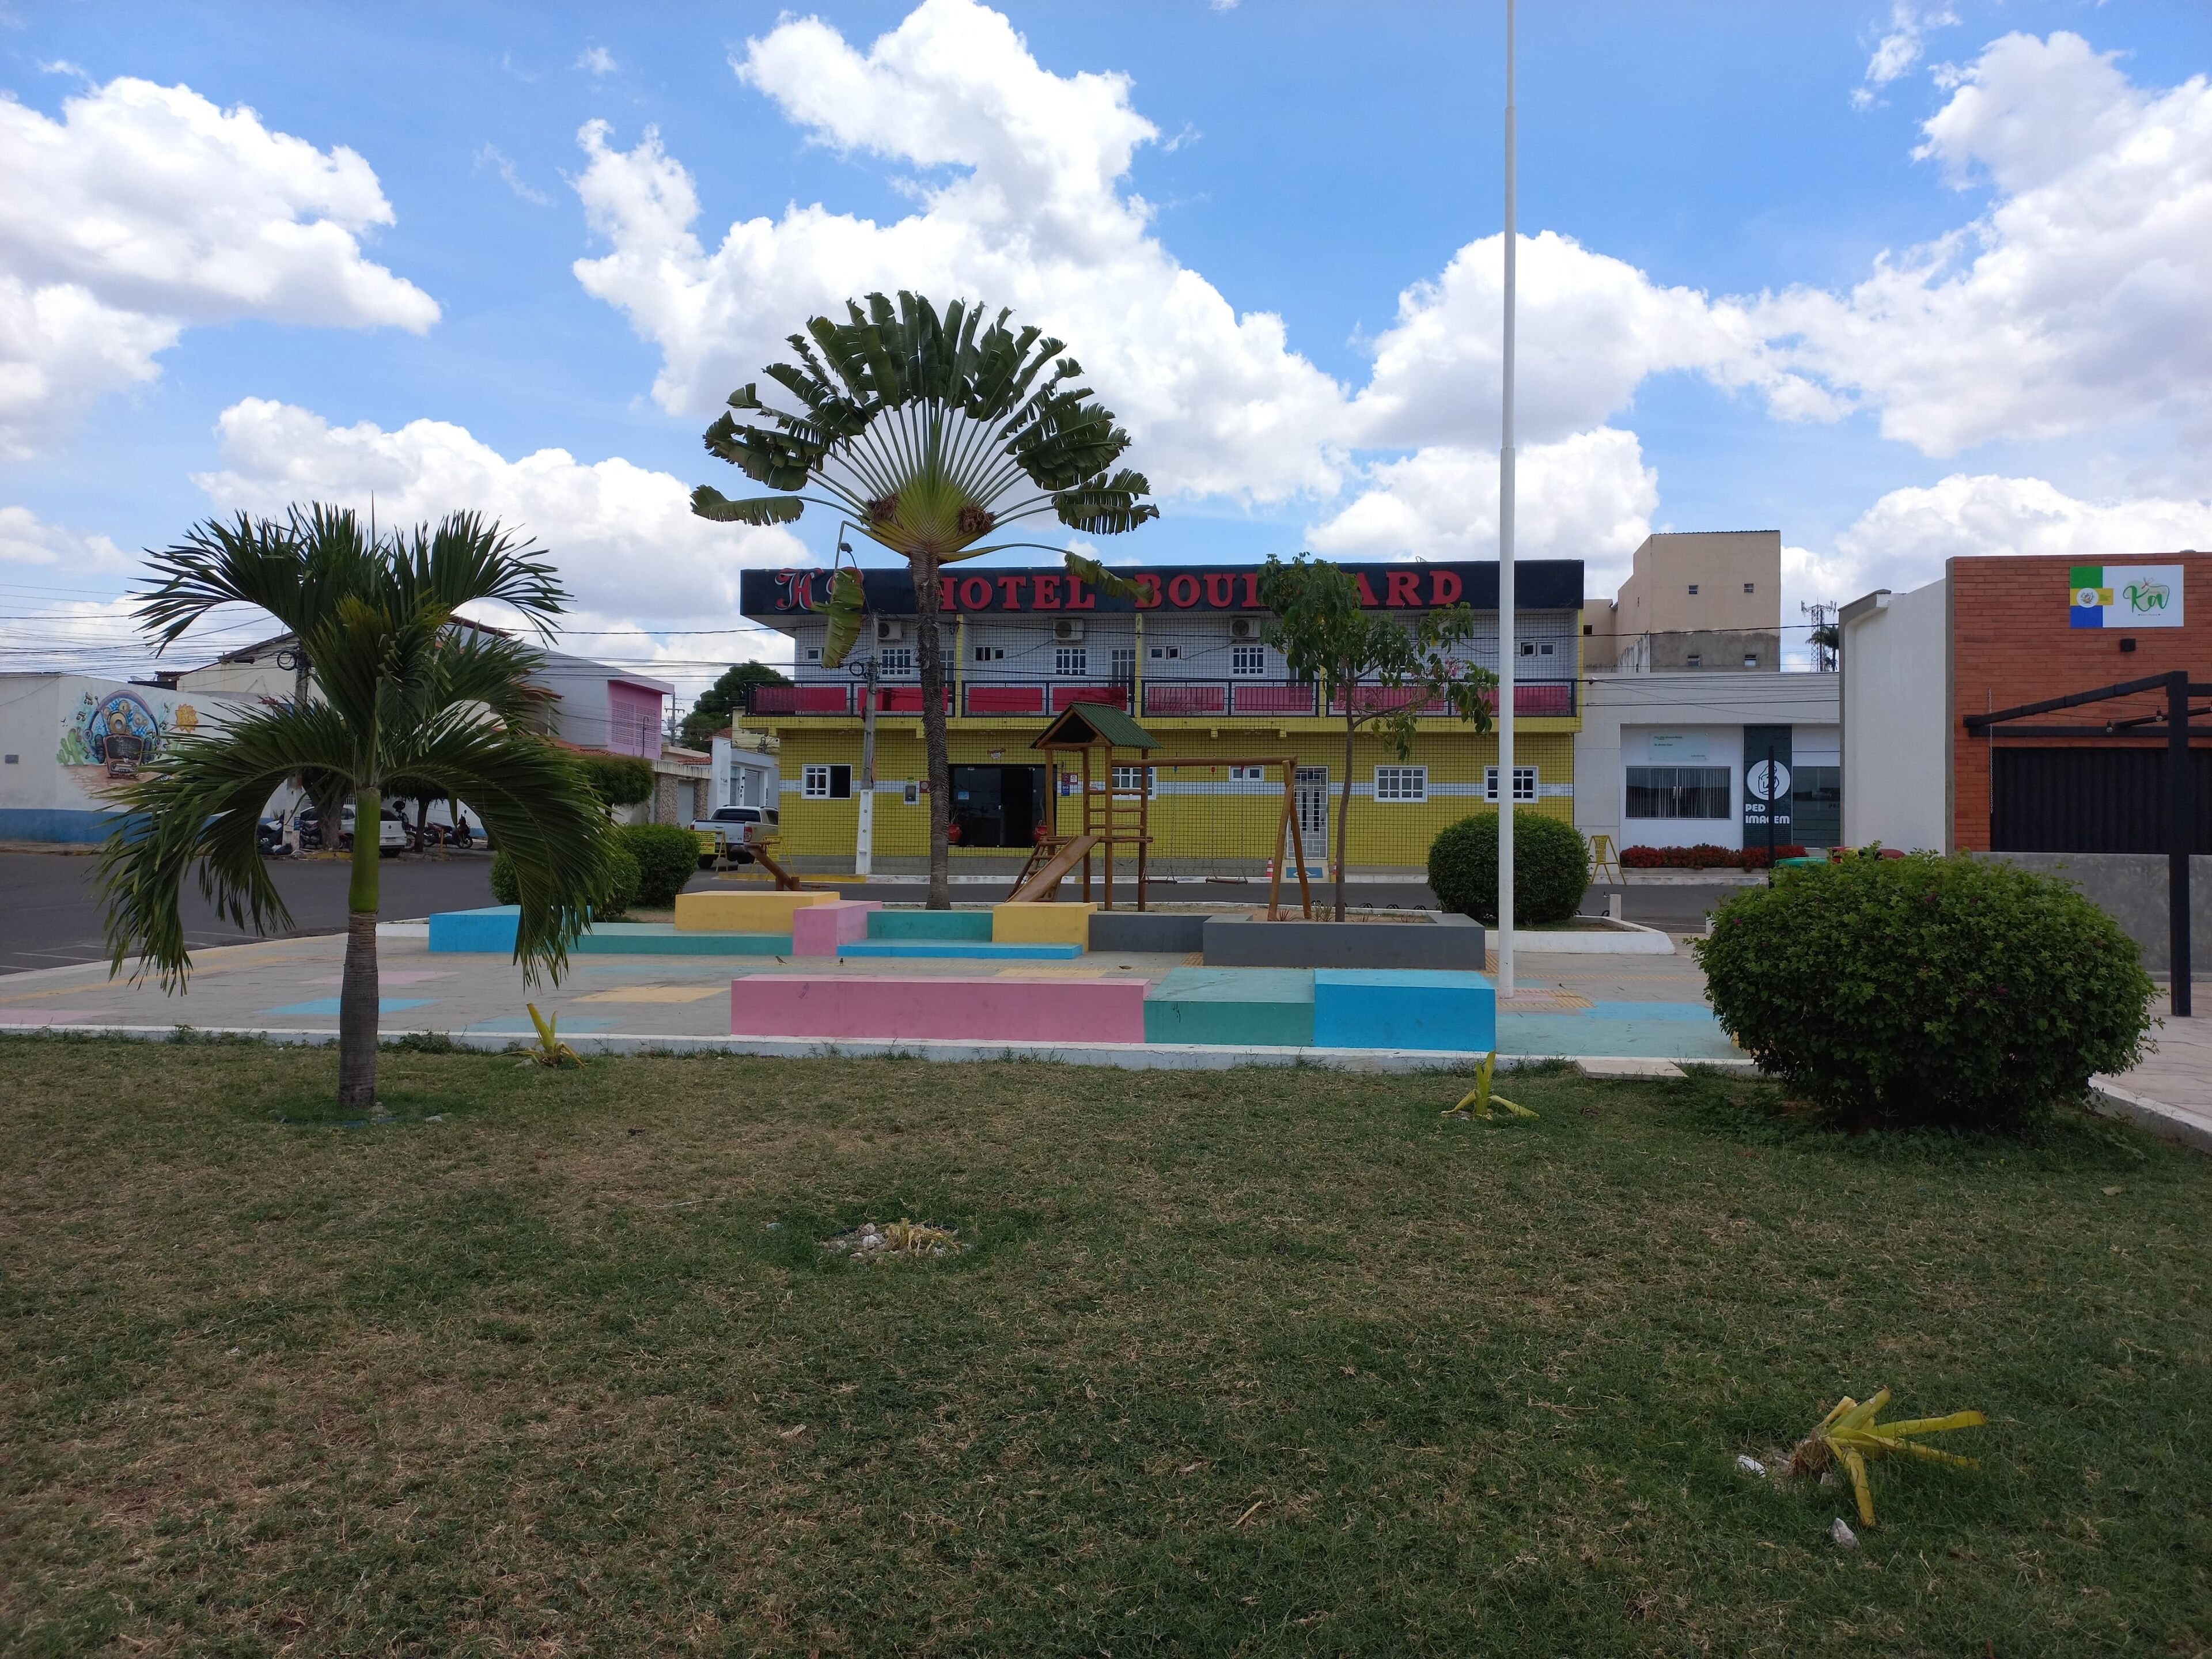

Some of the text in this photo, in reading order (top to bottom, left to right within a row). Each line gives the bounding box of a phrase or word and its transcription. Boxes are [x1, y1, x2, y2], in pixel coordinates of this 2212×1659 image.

[1134, 569, 1463, 609] BOULARD
[1745, 803, 1766, 812] PED
[1745, 815, 1790, 824] IMAEM
